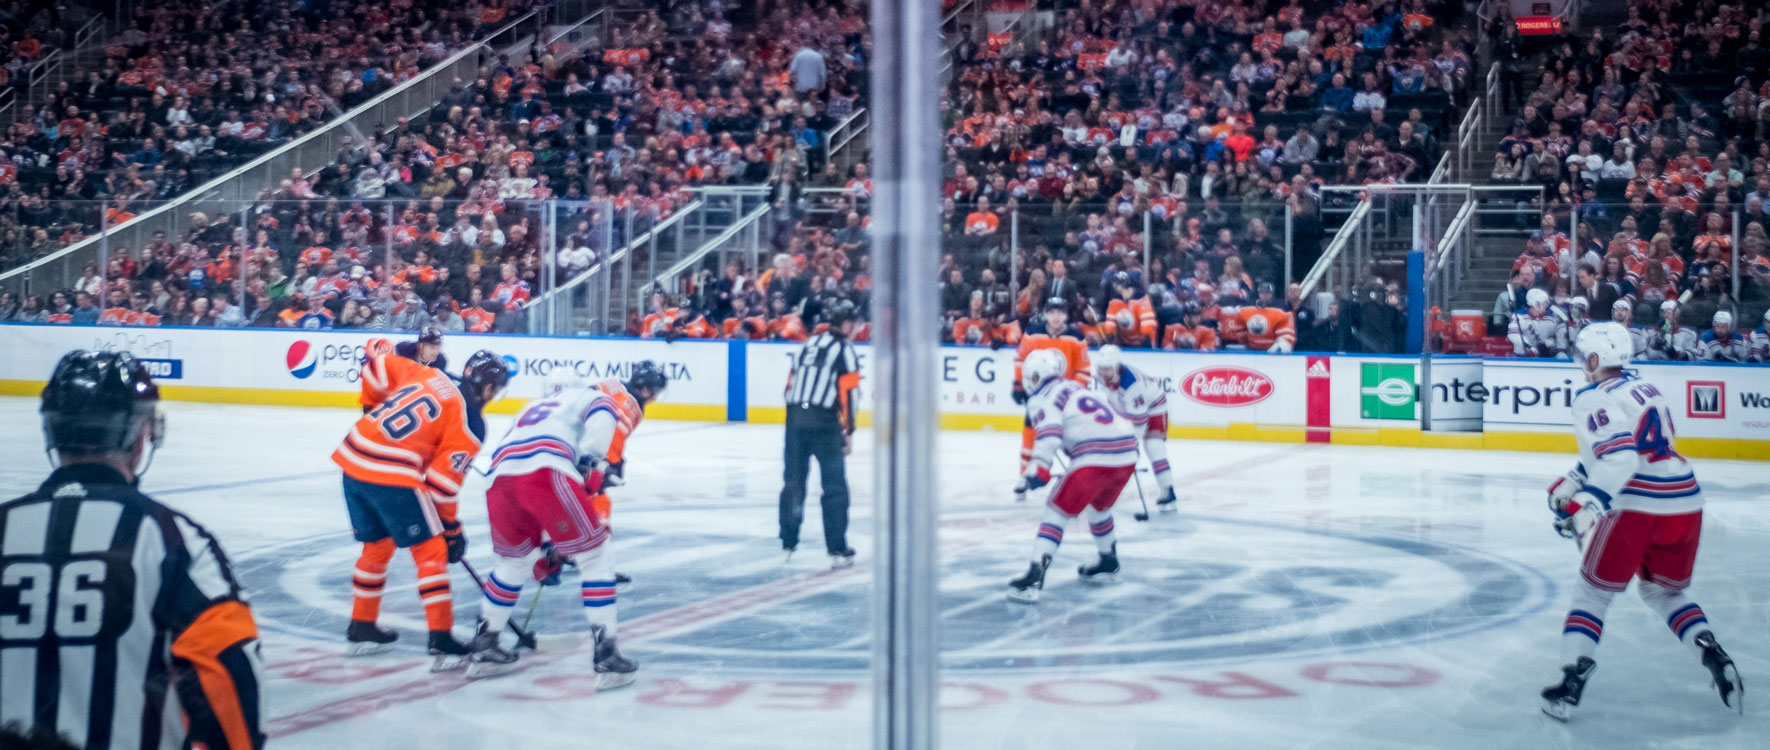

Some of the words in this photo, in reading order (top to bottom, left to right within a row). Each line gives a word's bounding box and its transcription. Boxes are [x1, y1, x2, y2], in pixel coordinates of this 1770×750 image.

[323, 344, 366, 365] pep
[525, 358, 600, 378] KOCA
[605, 361, 692, 381] MILTA
[943, 356, 995, 383] EG
[956, 391, 995, 404] BAR
[1190, 373, 1268, 397] Peterbilt
[1361, 378, 1572, 414] enterpri
[366, 382, 443, 441] 46
[0, 559, 107, 640] 36
